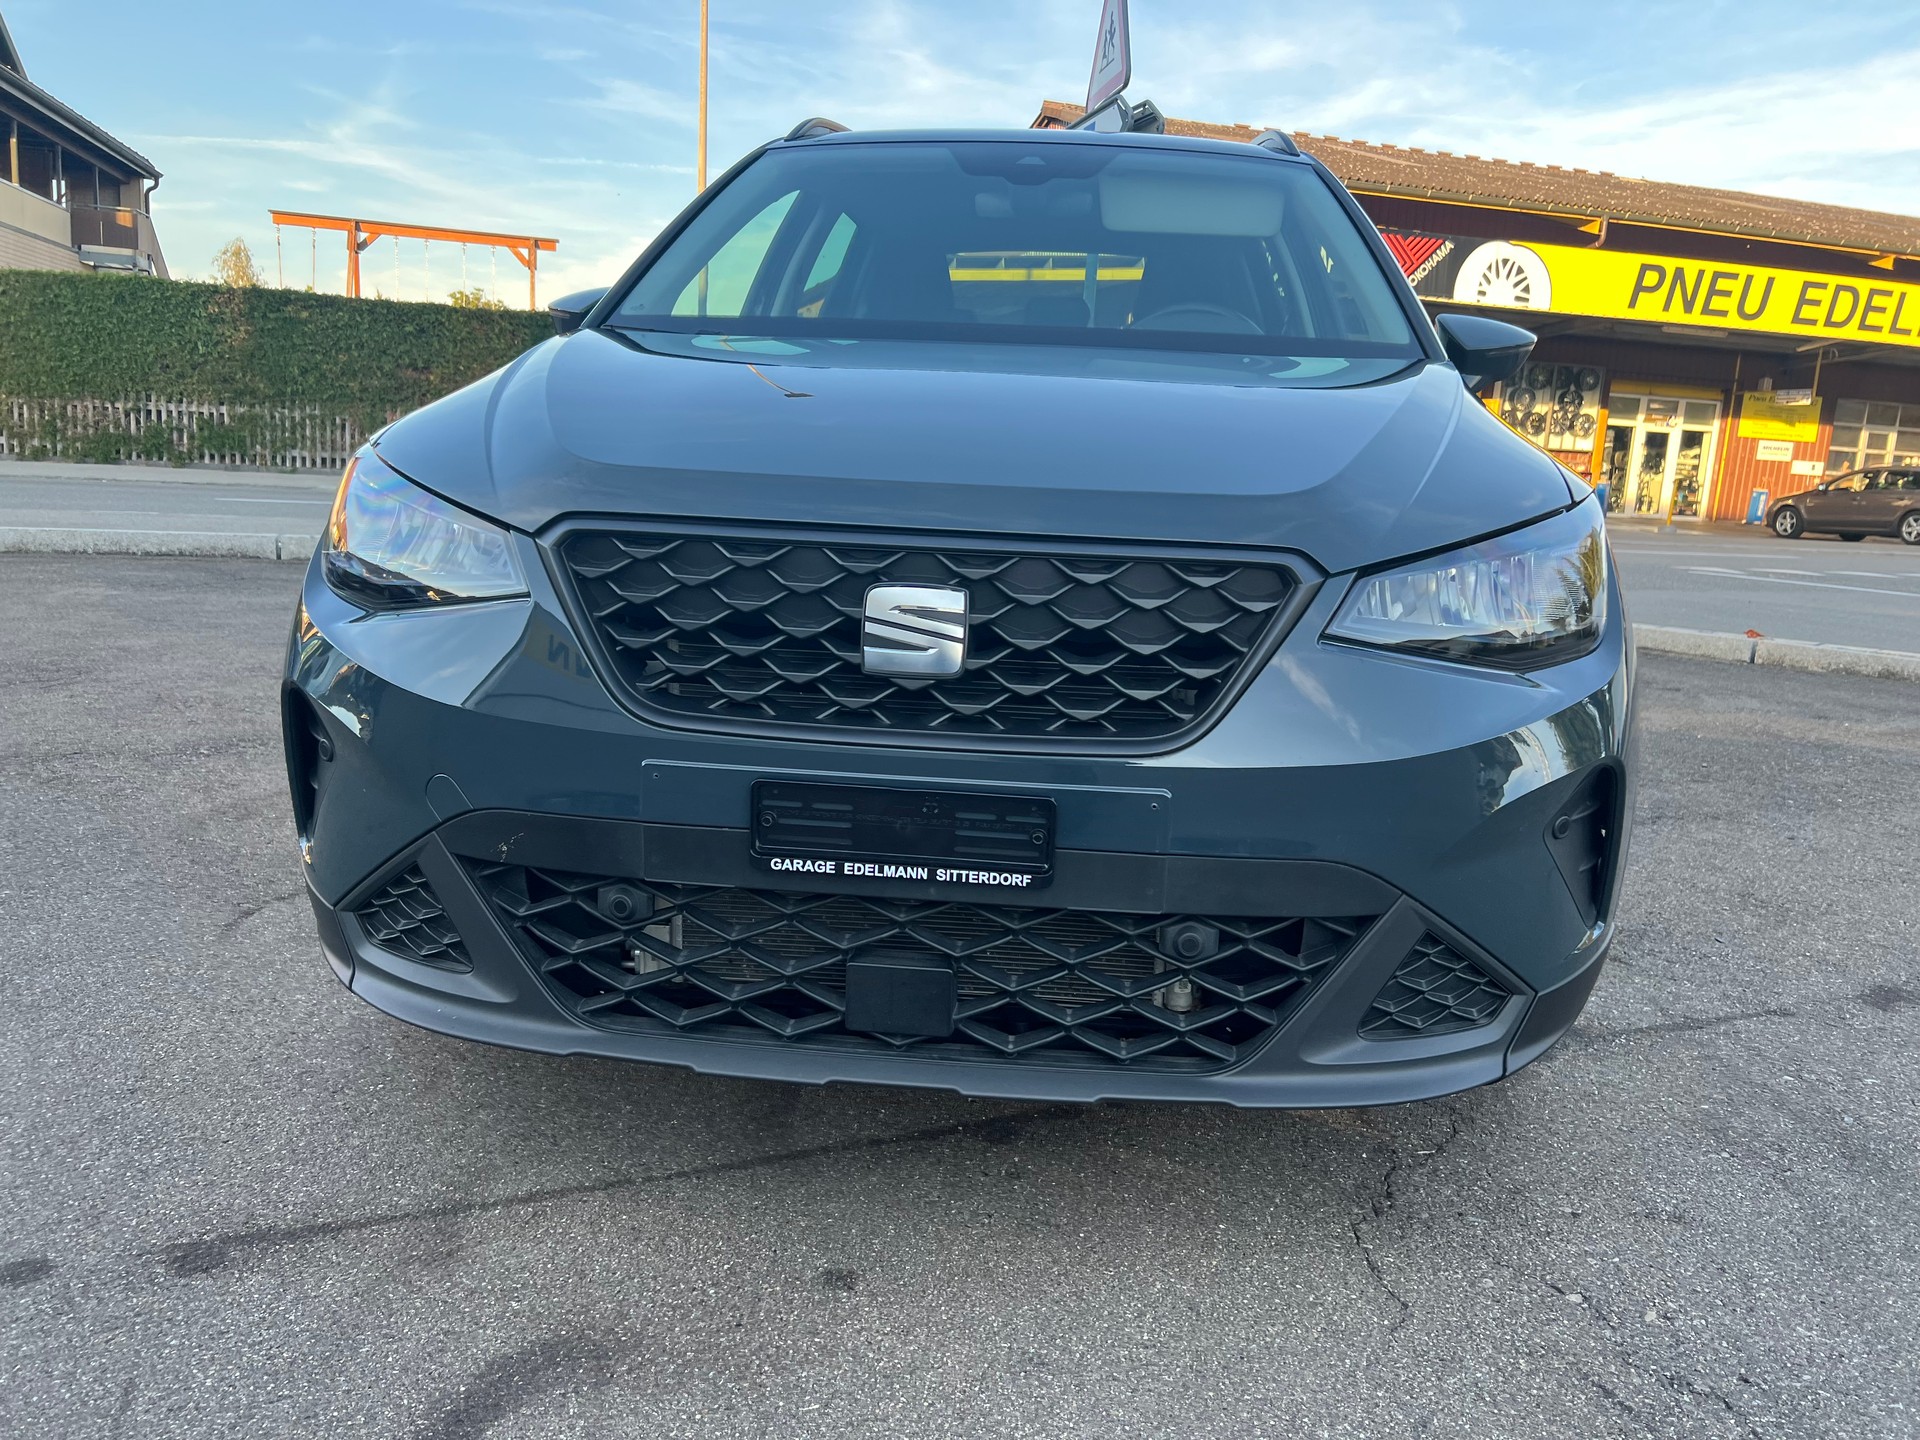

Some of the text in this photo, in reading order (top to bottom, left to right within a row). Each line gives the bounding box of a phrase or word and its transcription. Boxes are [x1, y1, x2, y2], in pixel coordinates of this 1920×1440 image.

[1407, 239, 1455, 287] OKOHAMA
[1628, 263, 1920, 337] PNEU EDEL
[770, 857, 1032, 887] GARAGE EDELMANN SITTERDORF
